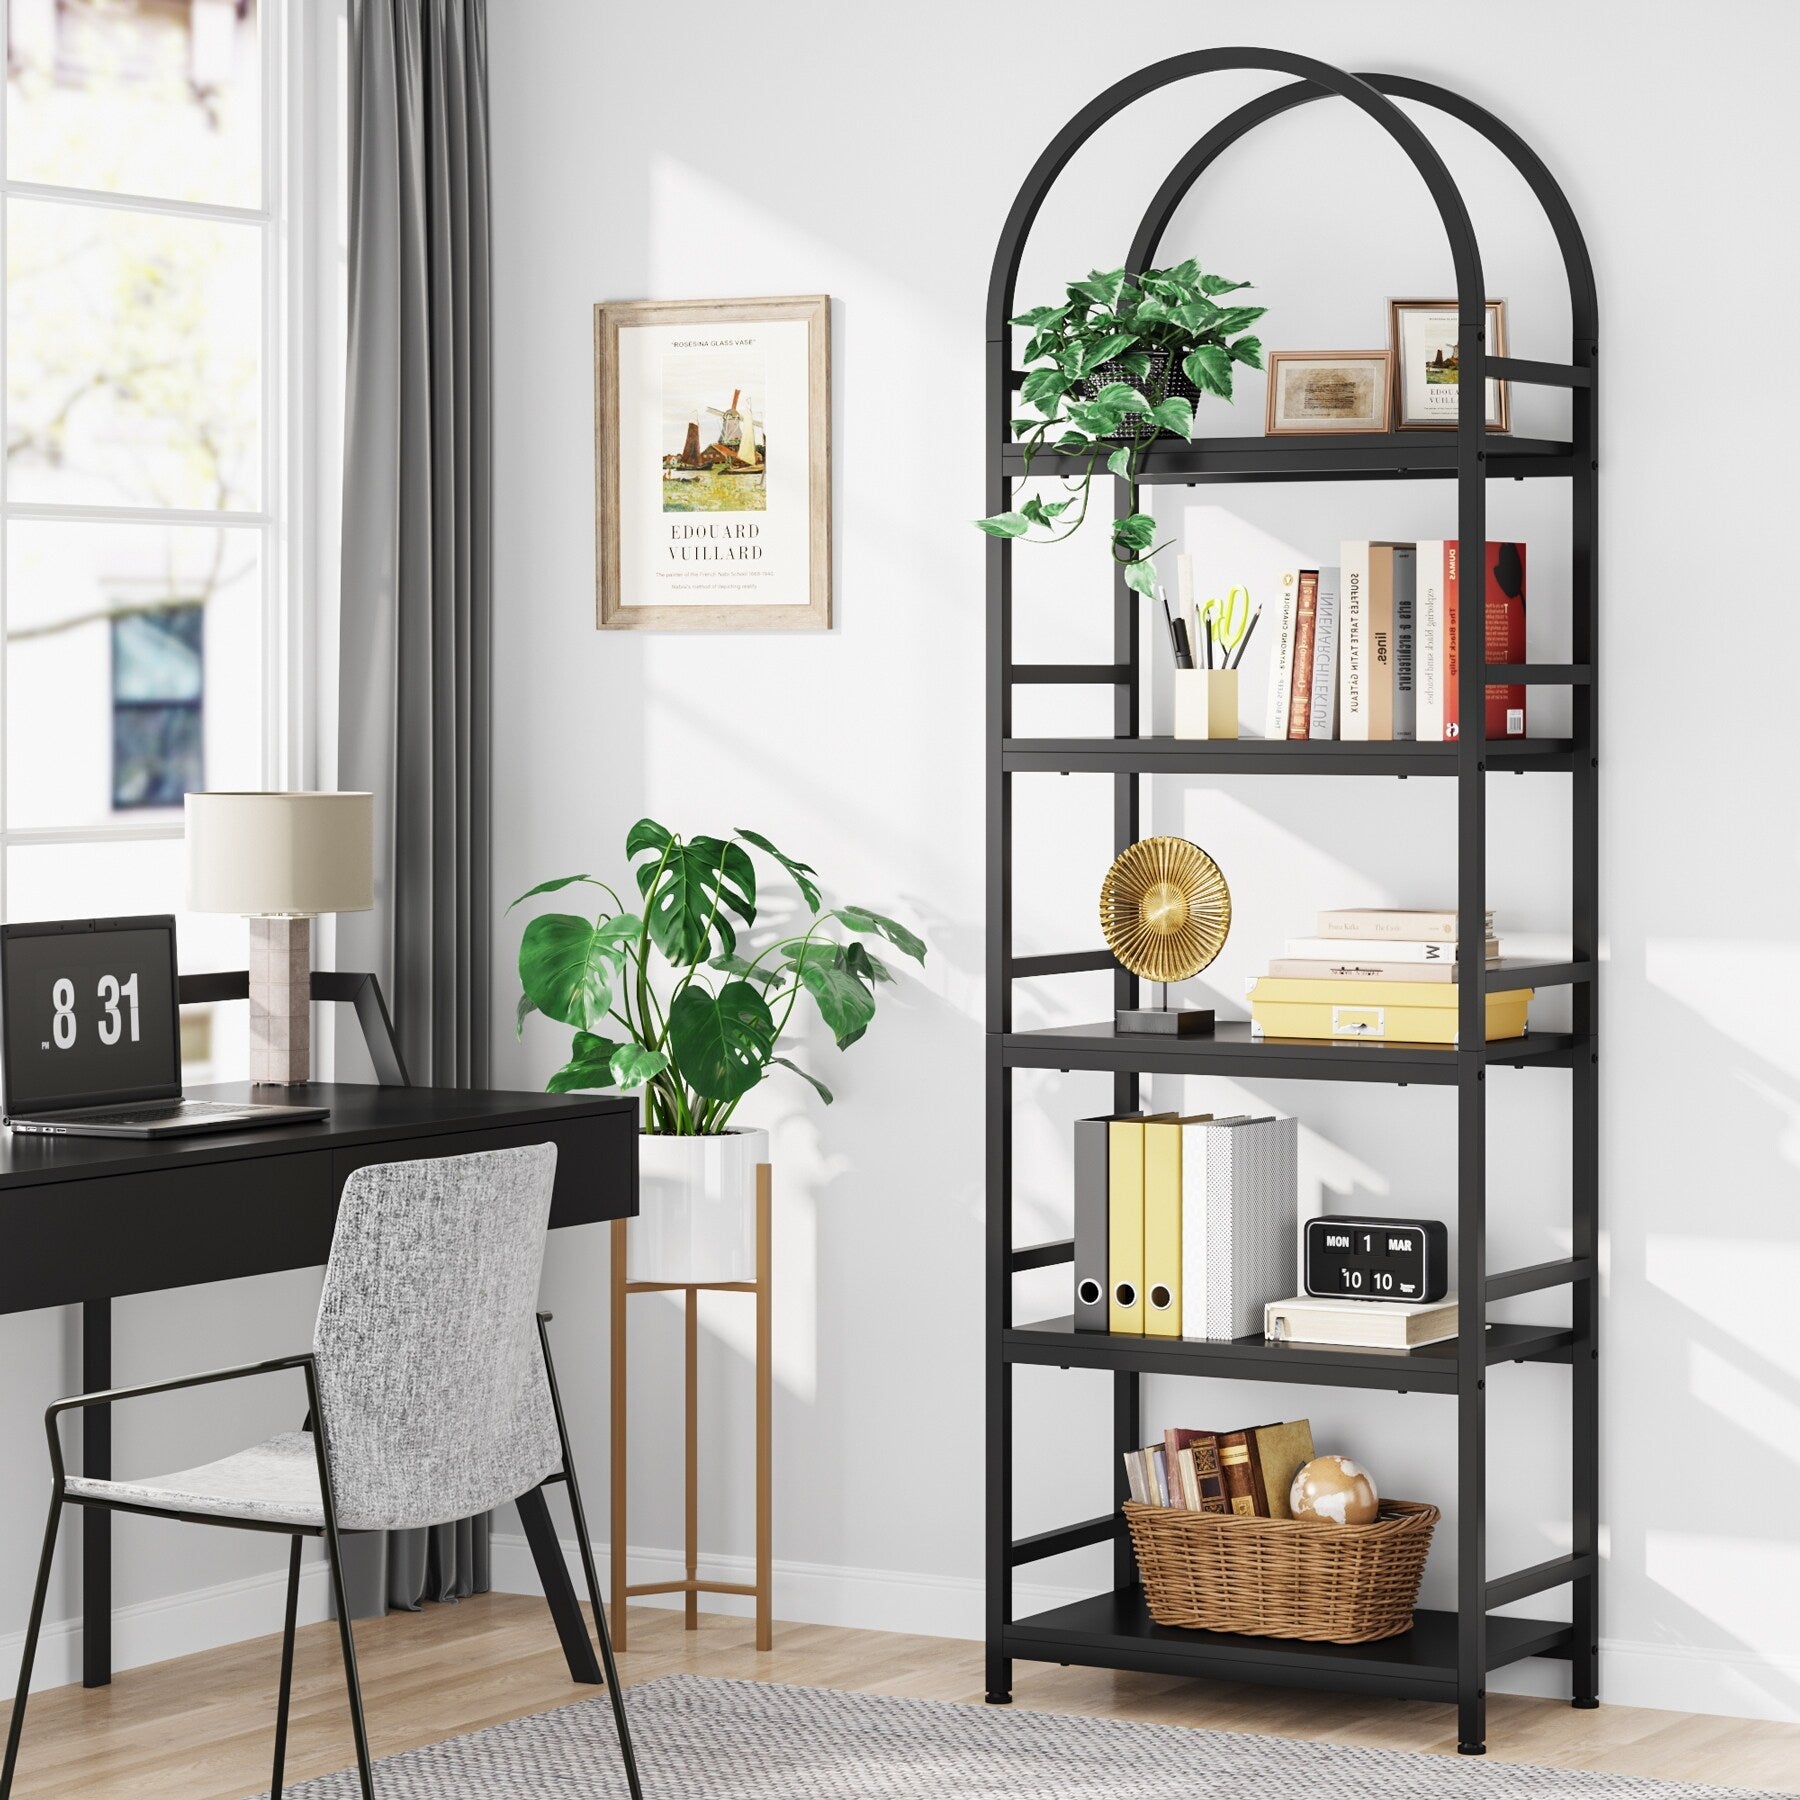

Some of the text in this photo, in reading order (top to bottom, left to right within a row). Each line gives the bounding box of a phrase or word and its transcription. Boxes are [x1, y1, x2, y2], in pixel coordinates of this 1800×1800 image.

[1430, 388, 1459, 396] EDOUA
[671, 523, 760, 540] EDOUARD
[669, 545, 763, 561] VUILLARD
[53, 973, 140, 1049] 8 31
[42, 1042, 50, 1050] PM
[1326, 1234, 1412, 1252] MON 1 MAR
[1342, 1271, 1362, 1288] 10
[1374, 1273, 1392, 1290] 10
